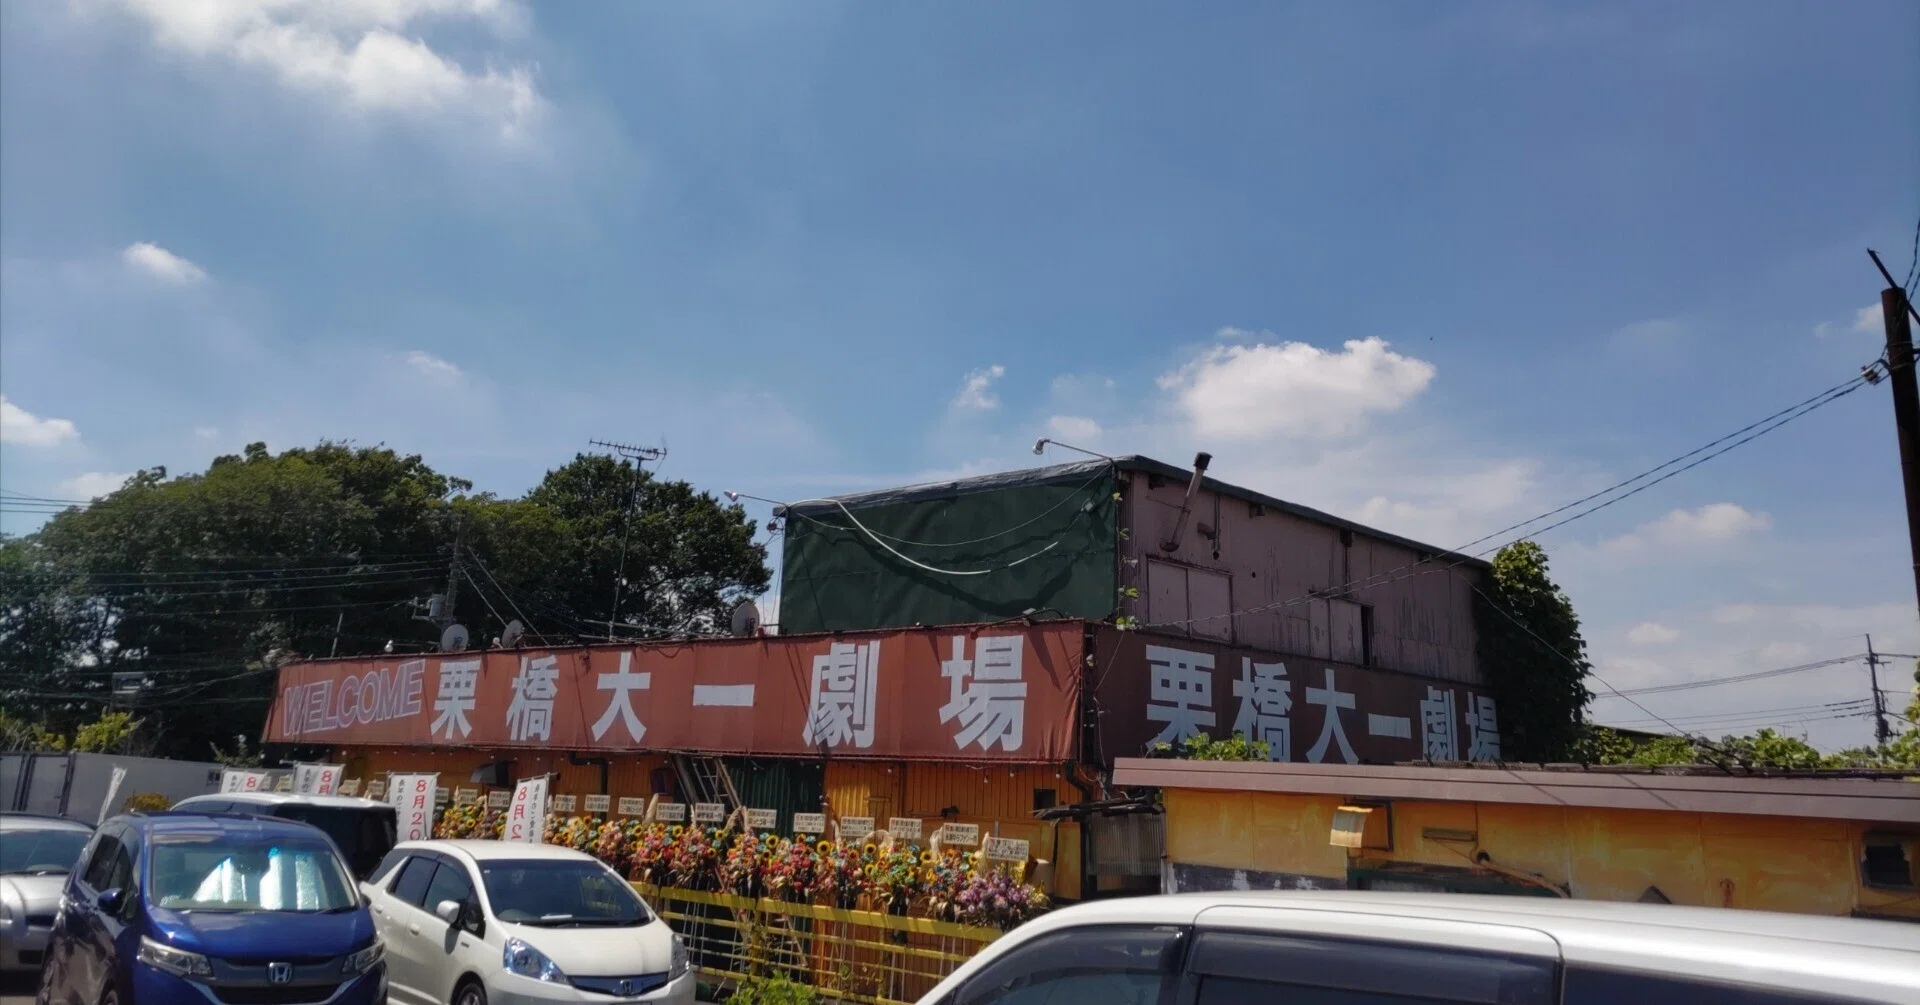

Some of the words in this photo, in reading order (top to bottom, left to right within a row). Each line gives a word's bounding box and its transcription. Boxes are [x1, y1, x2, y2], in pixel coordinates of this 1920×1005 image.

[282, 658, 426, 738] WELCOME
[430, 634, 1028, 752] 栗橋大一劇場
